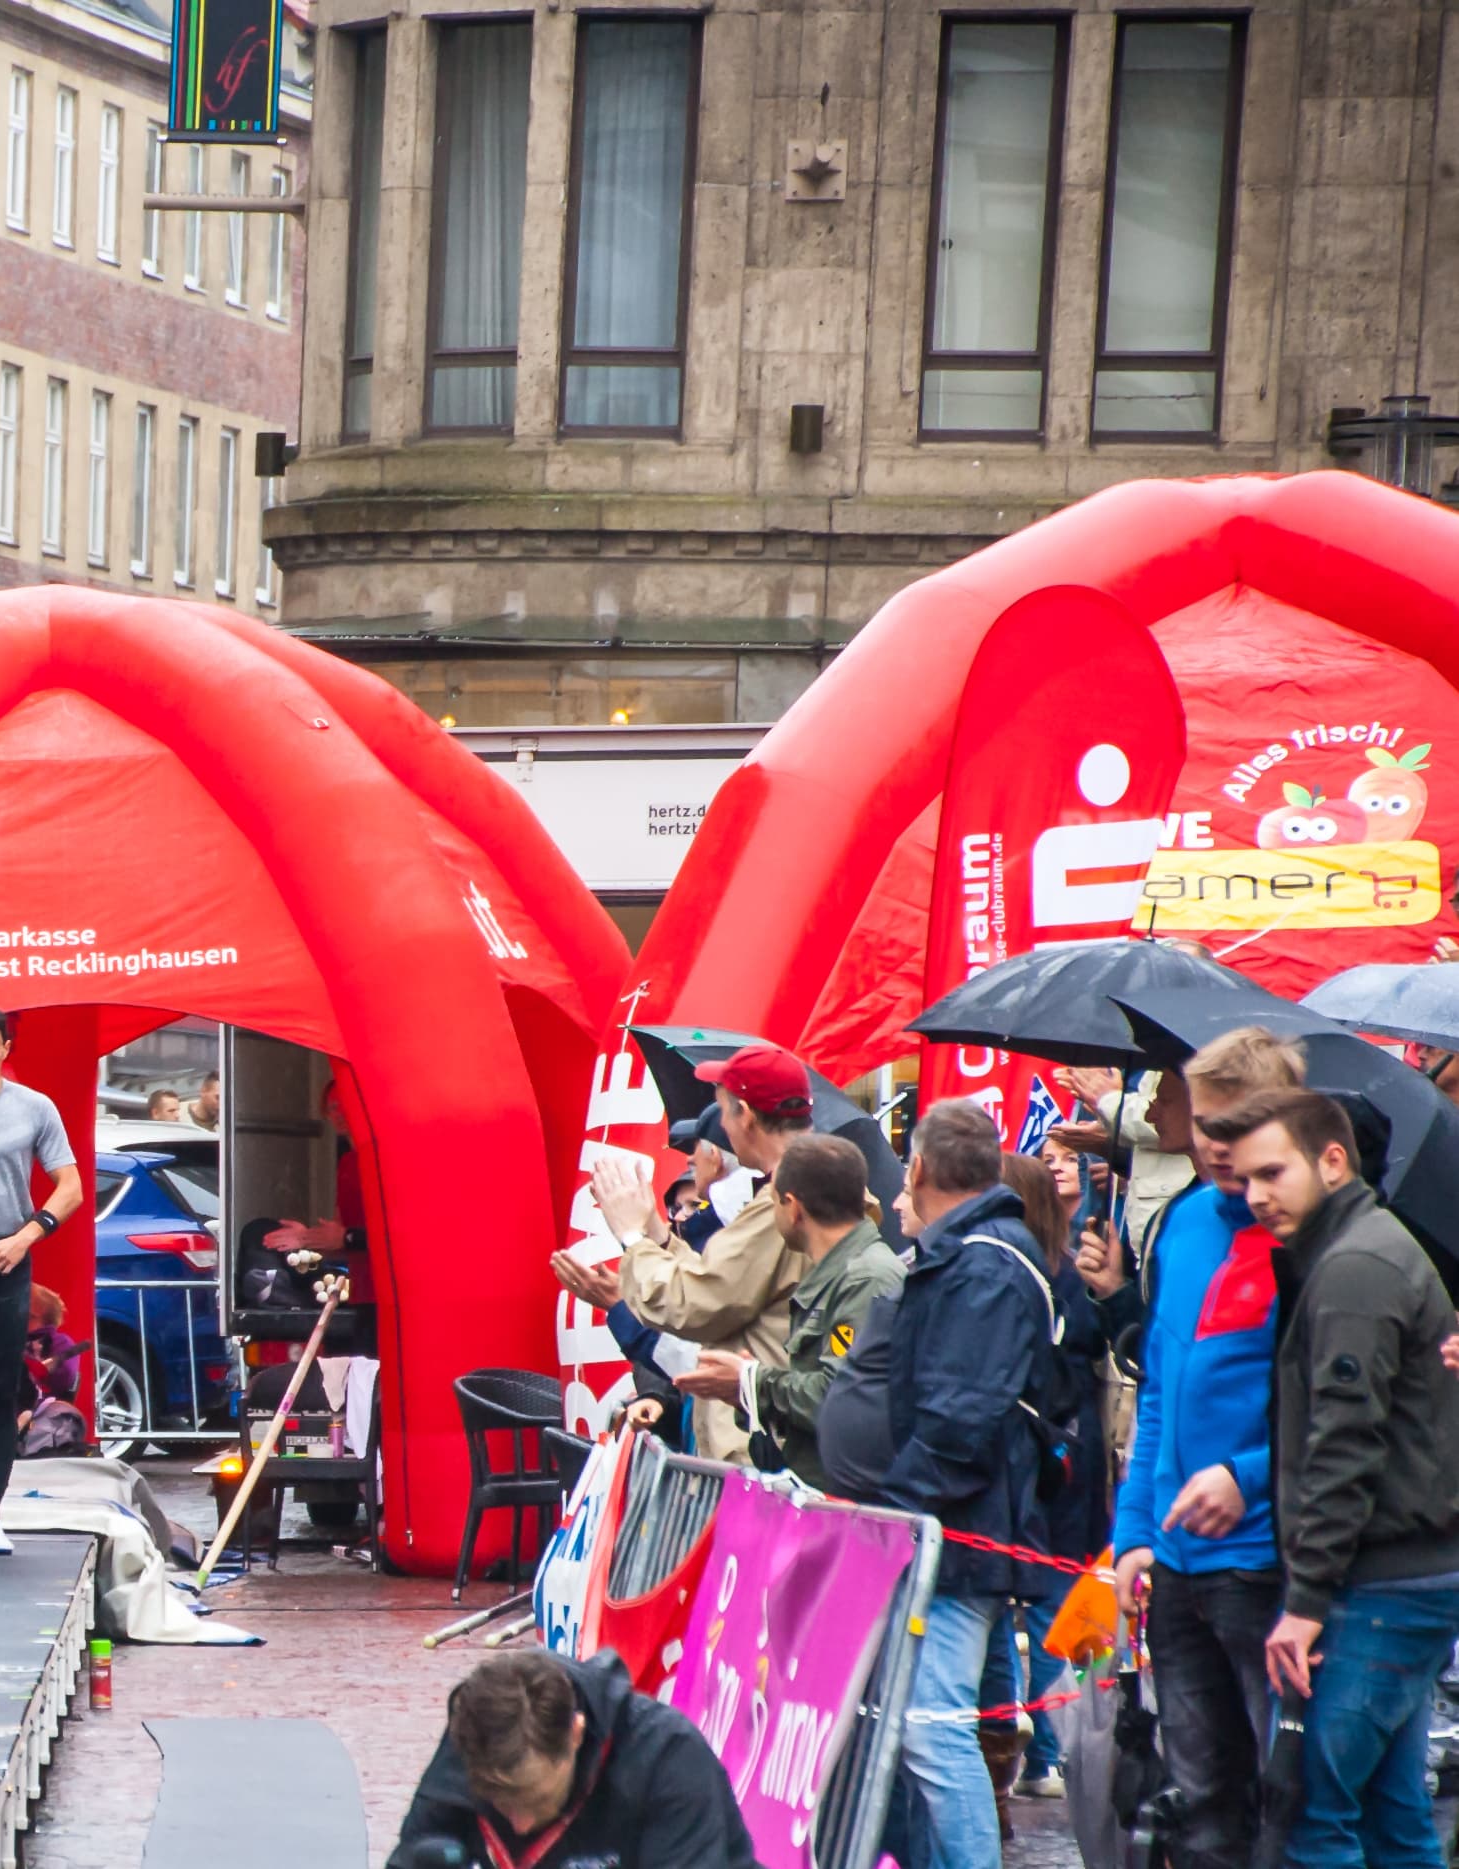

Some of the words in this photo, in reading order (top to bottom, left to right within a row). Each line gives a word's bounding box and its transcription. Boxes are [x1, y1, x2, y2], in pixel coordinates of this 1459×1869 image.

[1222, 743, 1289, 803] Alles
[1290, 721, 1405, 752] frisch!
[28, 946, 238, 976] Recklinghausen
